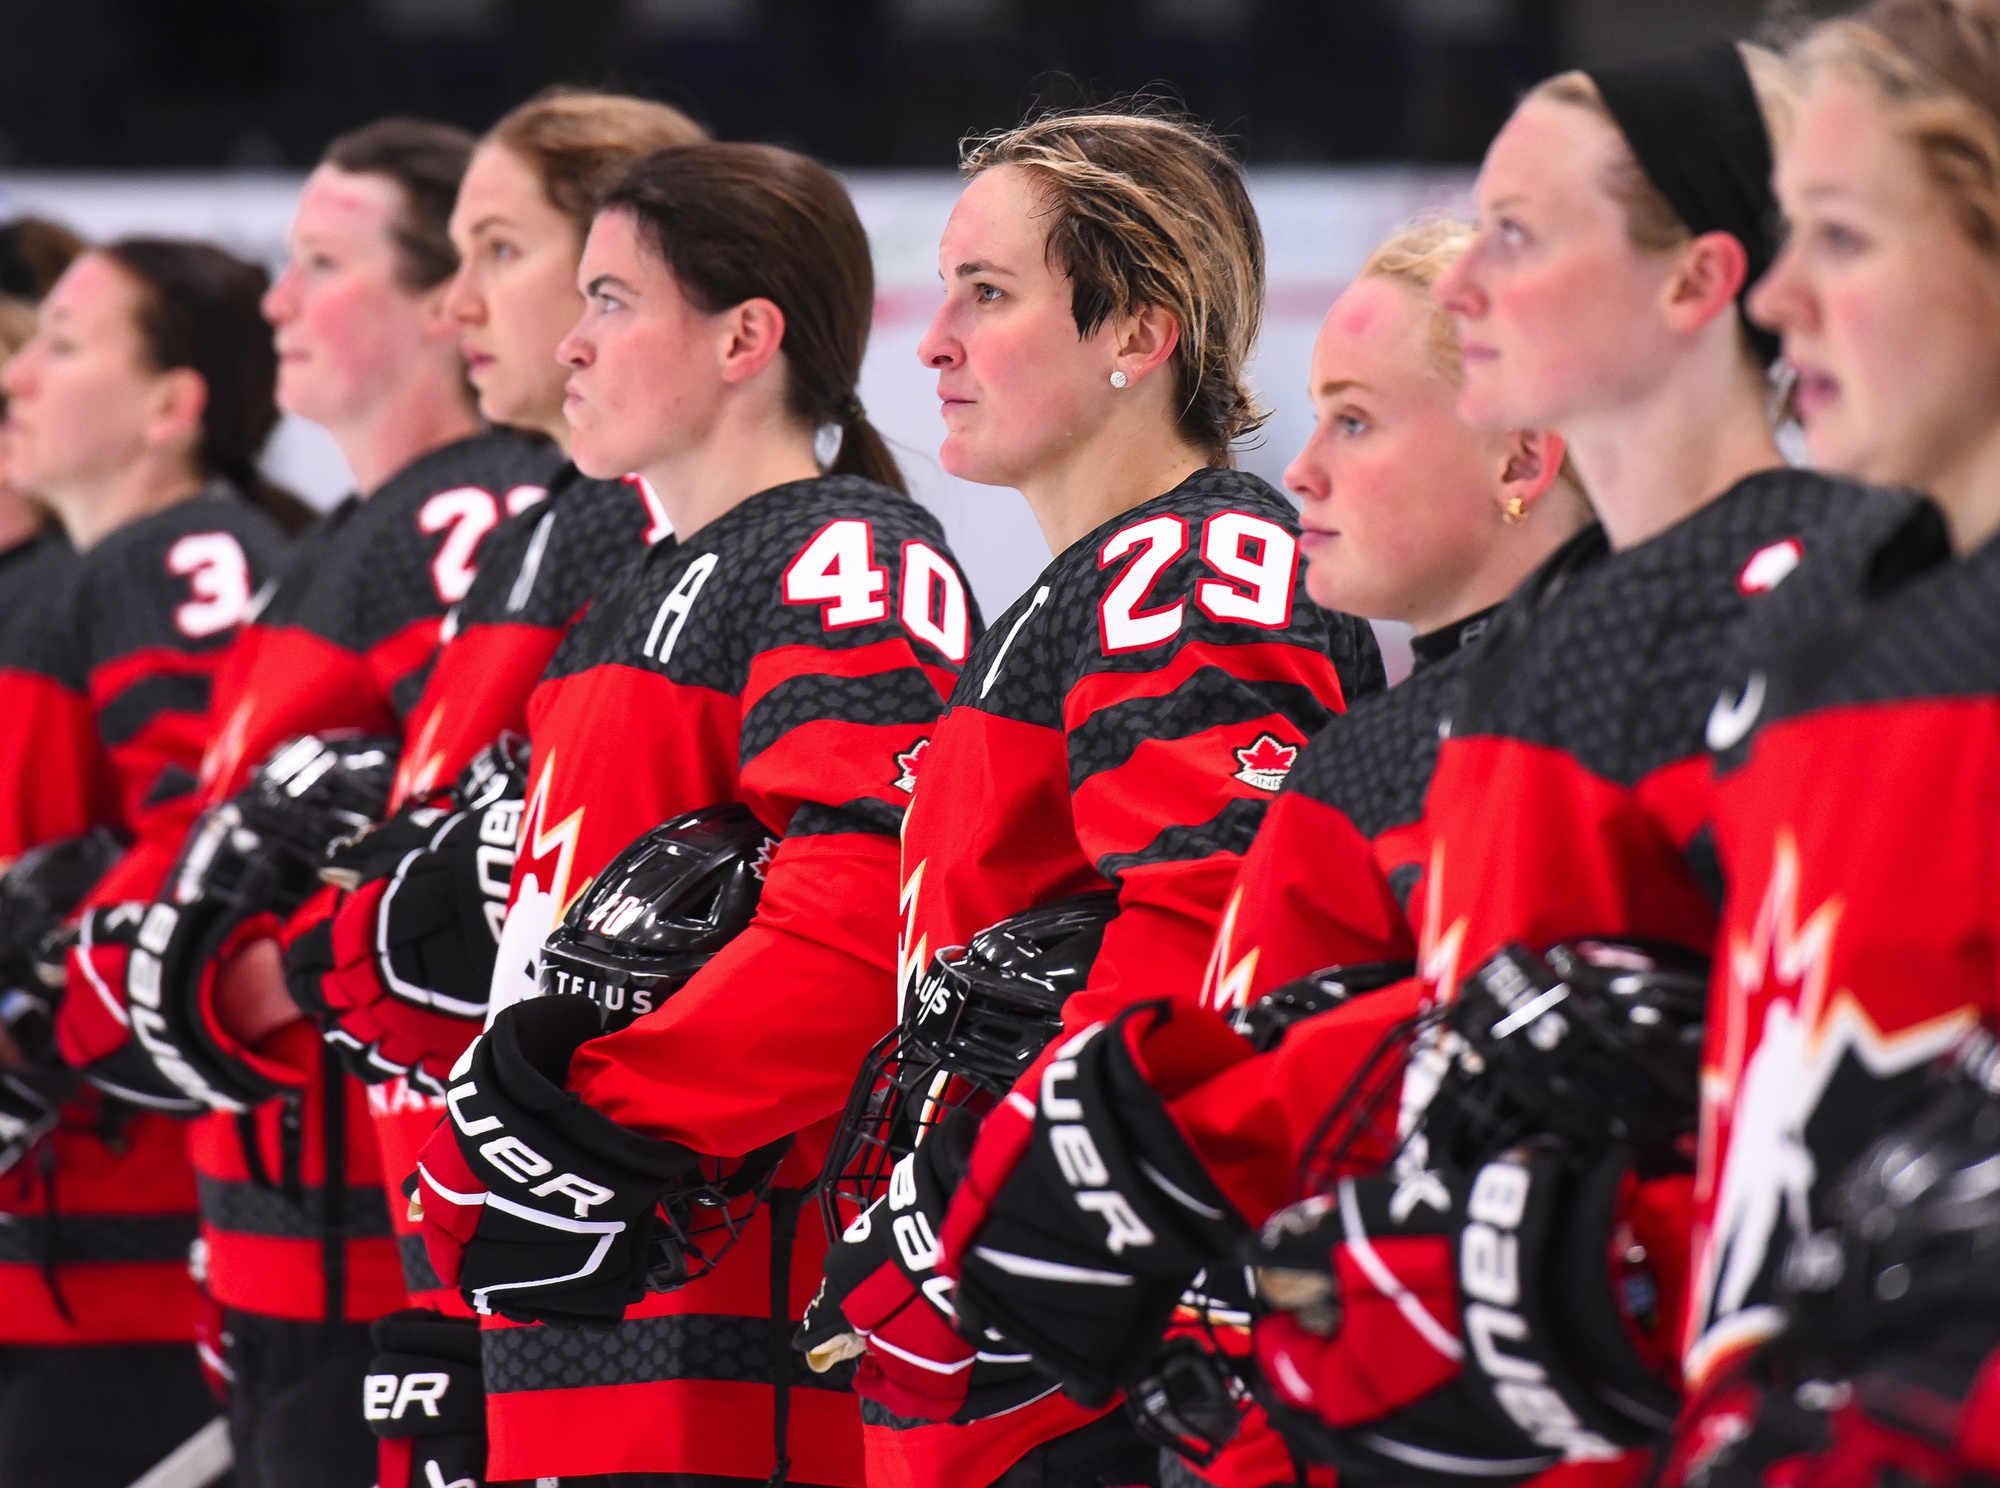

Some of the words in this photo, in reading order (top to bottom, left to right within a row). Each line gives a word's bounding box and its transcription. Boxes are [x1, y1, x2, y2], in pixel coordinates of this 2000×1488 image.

[166, 530, 252, 640] 3
[417, 484, 548, 606] 2
[782, 518, 971, 663] 40
[1100, 510, 1300, 655] 29
[643, 552, 718, 664] A
[586, 892, 644, 936] 40
